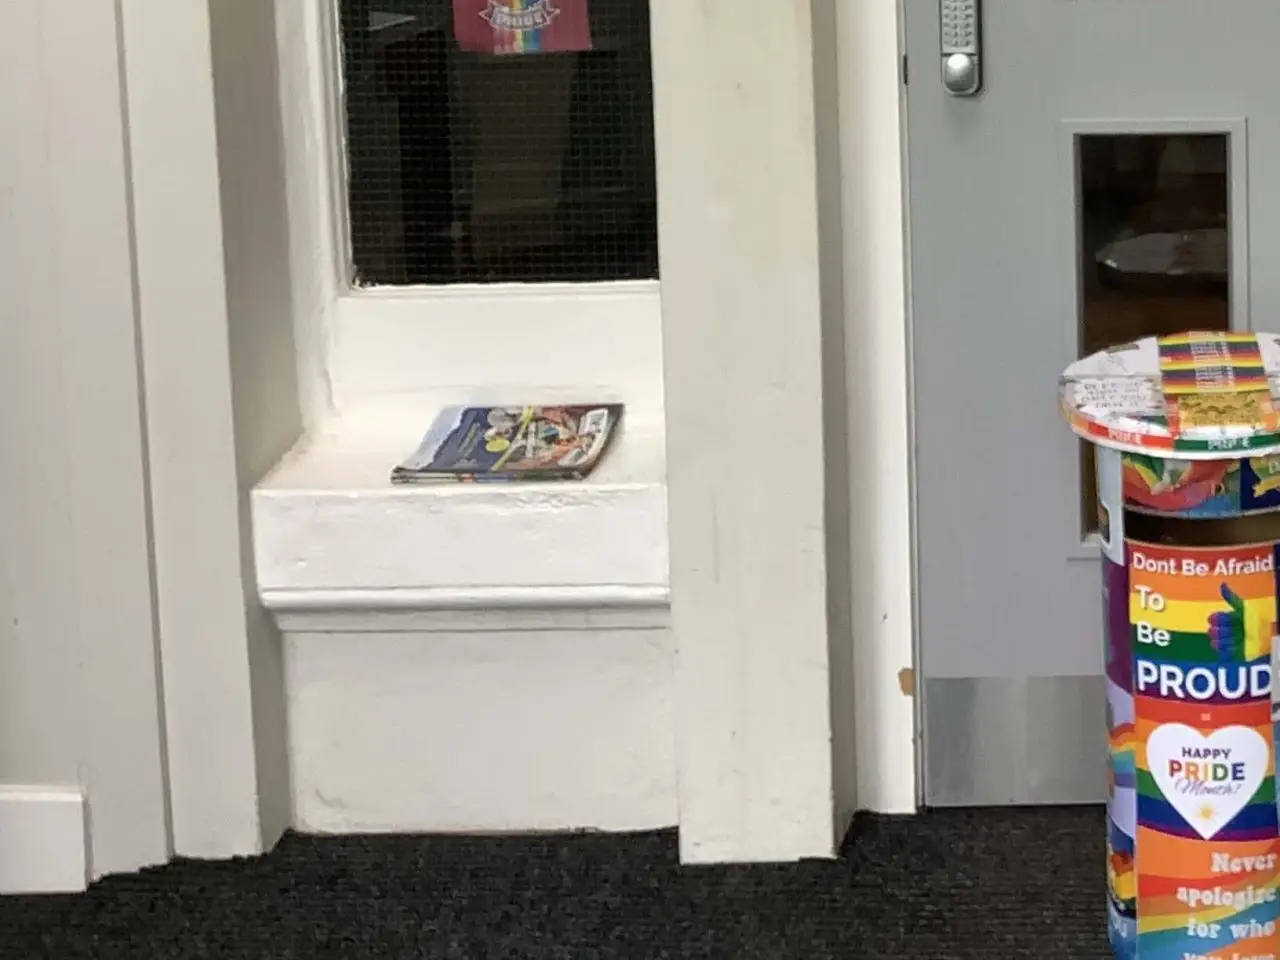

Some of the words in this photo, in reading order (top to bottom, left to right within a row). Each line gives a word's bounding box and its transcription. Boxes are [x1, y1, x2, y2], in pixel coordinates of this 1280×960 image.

[1133, 553, 1177, 575] Dont
[1182, 559, 1209, 576] Be
[1213, 556, 1273, 576] Afraid
[1134, 585, 1165, 611] To
[1137, 623, 1171, 646] Be
[1137, 660, 1272, 700] PROUD
[1181, 746, 1232, 760] HAPPY
[1168, 758, 1246, 781] PRIDE
[1211, 852, 1276, 872] Never
[1187, 918, 1221, 938] for
[1230, 918, 1276, 938] who
